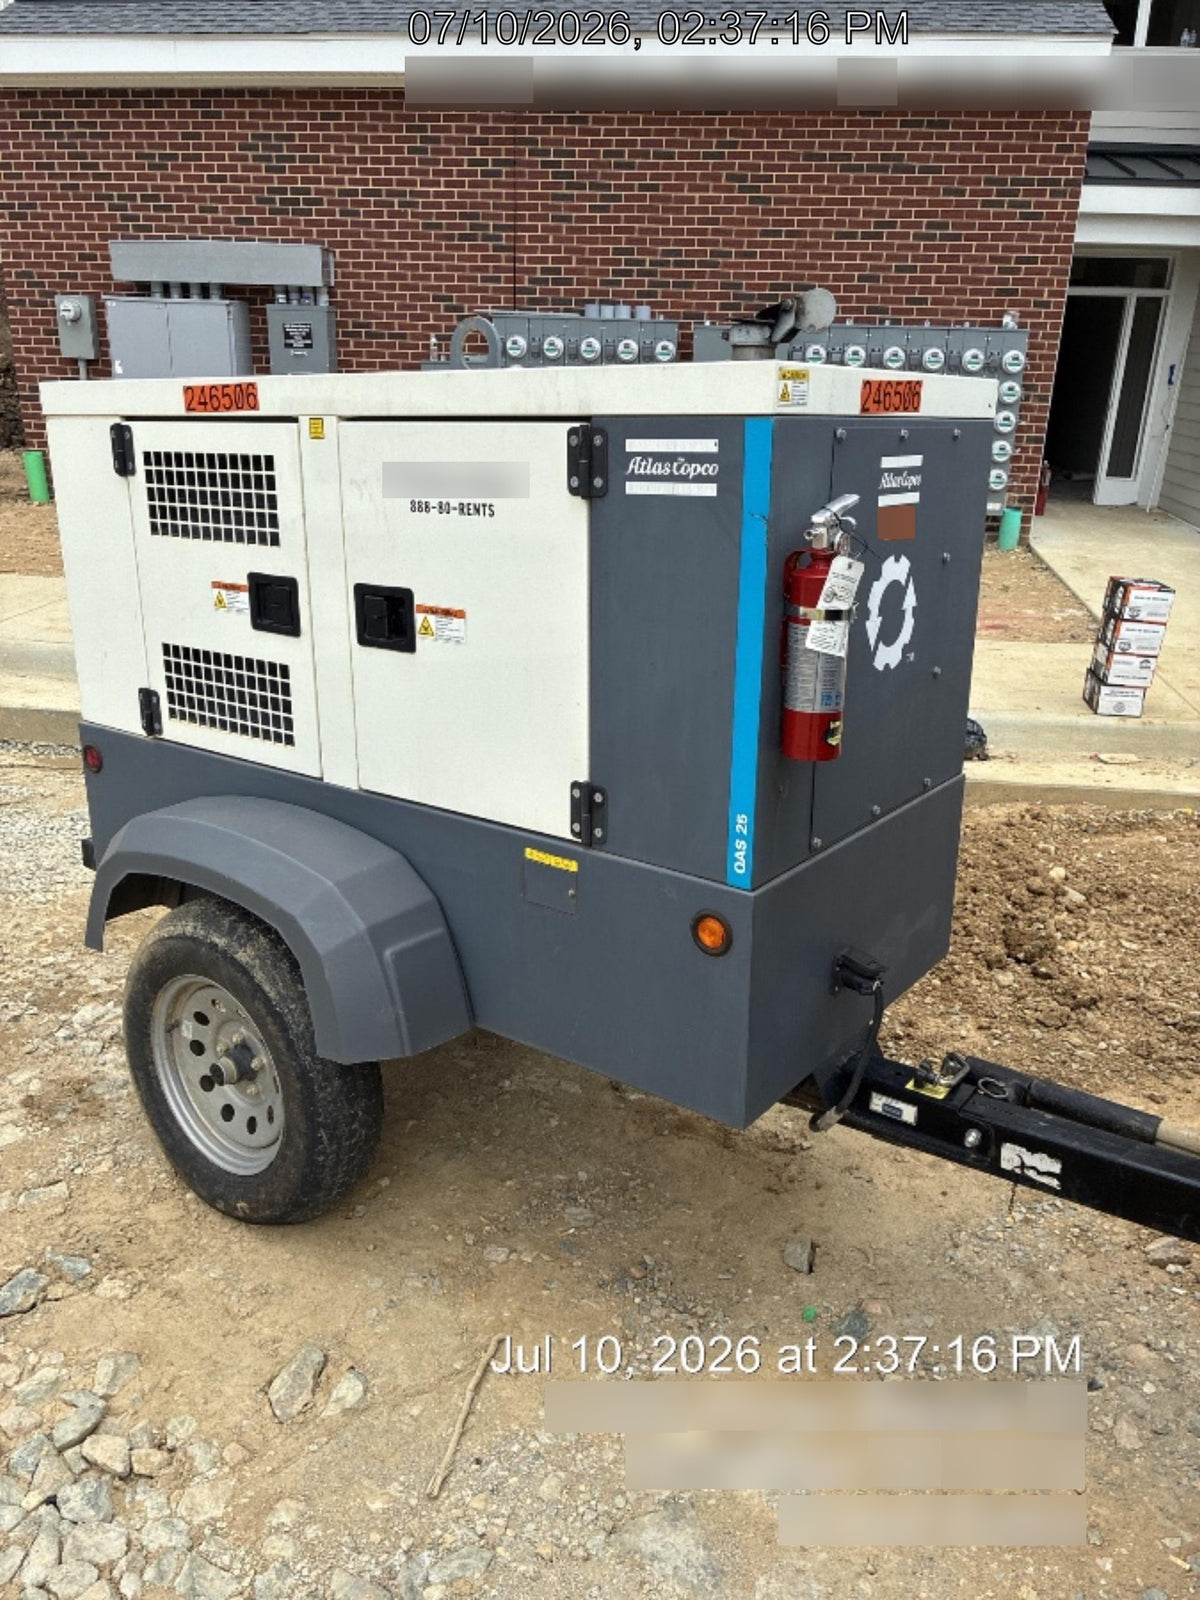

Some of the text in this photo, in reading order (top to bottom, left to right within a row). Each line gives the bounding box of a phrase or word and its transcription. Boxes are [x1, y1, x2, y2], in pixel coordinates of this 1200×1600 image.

[185, 383, 258, 411] 246506
[860, 380, 922, 412] 246506
[625, 456, 719, 480] Atlas Copco
[735, 813, 748, 836] 25
